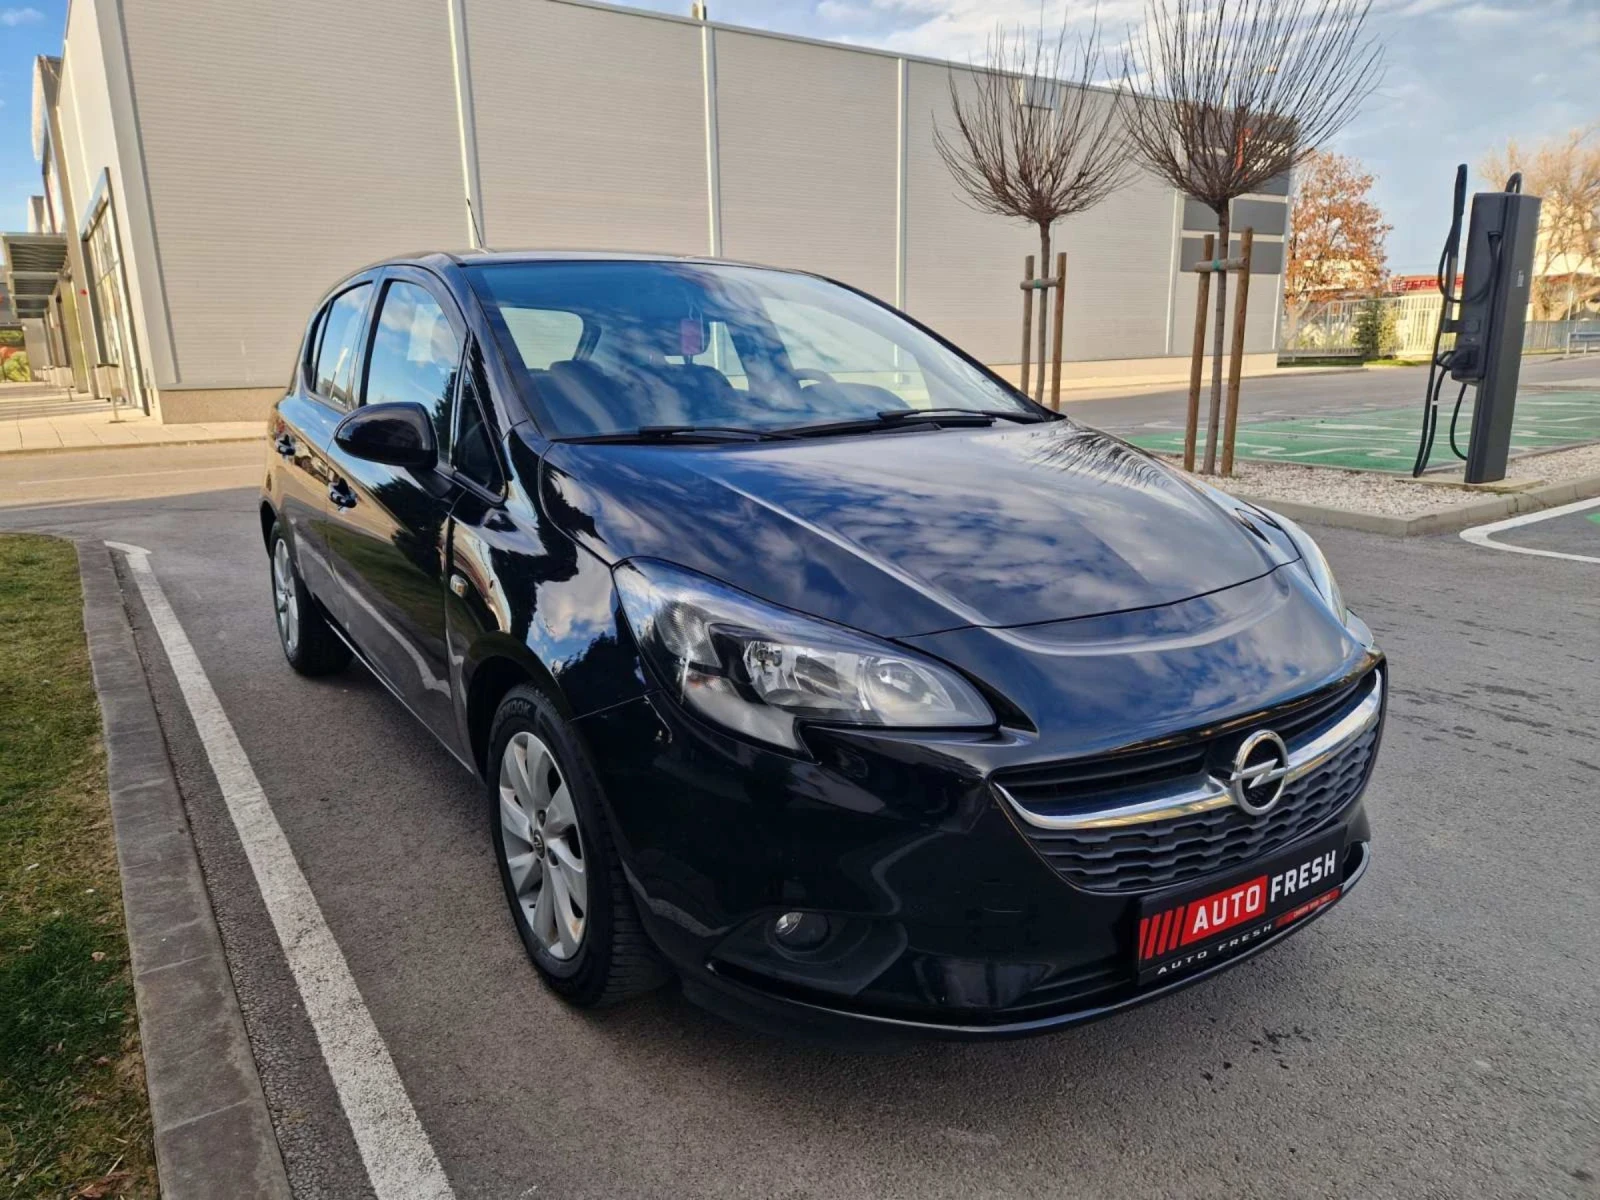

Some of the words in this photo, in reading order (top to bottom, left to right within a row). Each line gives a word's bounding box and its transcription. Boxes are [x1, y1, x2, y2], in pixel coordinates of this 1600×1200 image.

[1192, 885, 1260, 934] AUTO
[1270, 850, 1336, 902] FRESH
[1157, 951, 1207, 975] AUTO
[1218, 924, 1272, 951] FRESH
